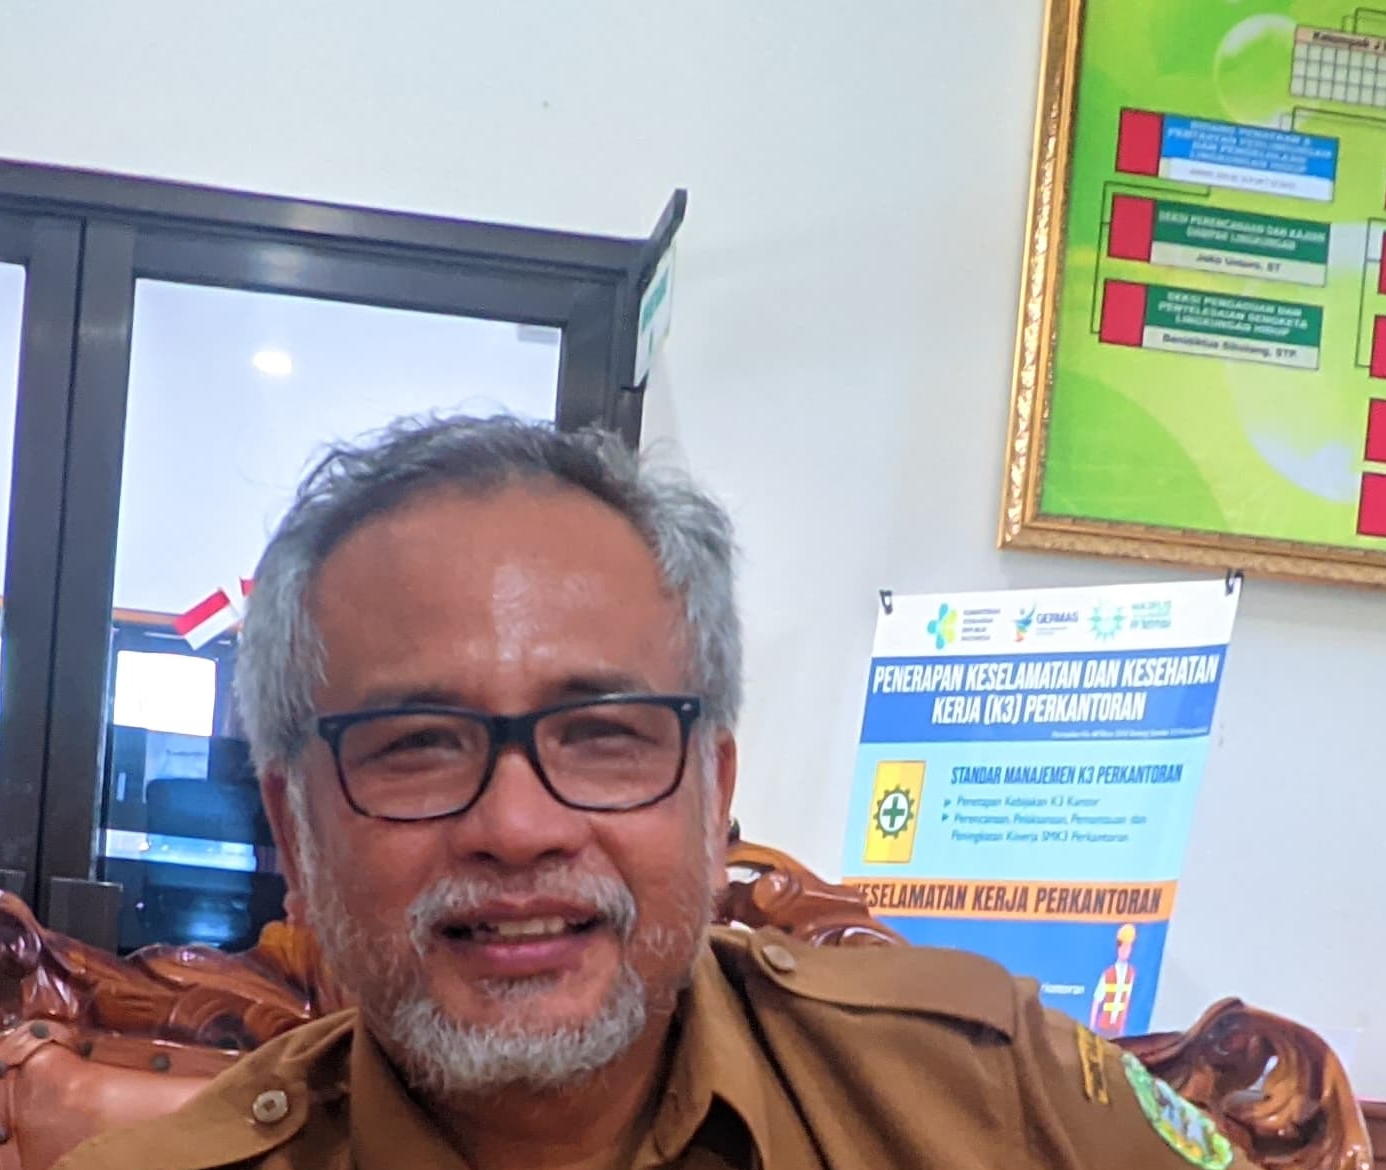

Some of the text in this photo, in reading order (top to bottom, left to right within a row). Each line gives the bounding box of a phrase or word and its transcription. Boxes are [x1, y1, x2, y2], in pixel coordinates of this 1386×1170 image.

[1036, 612, 1079, 625] GERMAS
[872, 654, 1221, 695] PENERAPAN KESELAMATAN DAN KESEHATAN
[931, 691, 1148, 726] KERJA (K3) PERKANTORAN
[950, 763, 1184, 785] STANDAR MANAJEMEN K3 PERKANTORAN
[1071, 830, 1129, 843] Perkantoran
[971, 885, 1028, 913] KERJA
[1033, 886, 1163, 915] PERKANTORAN
